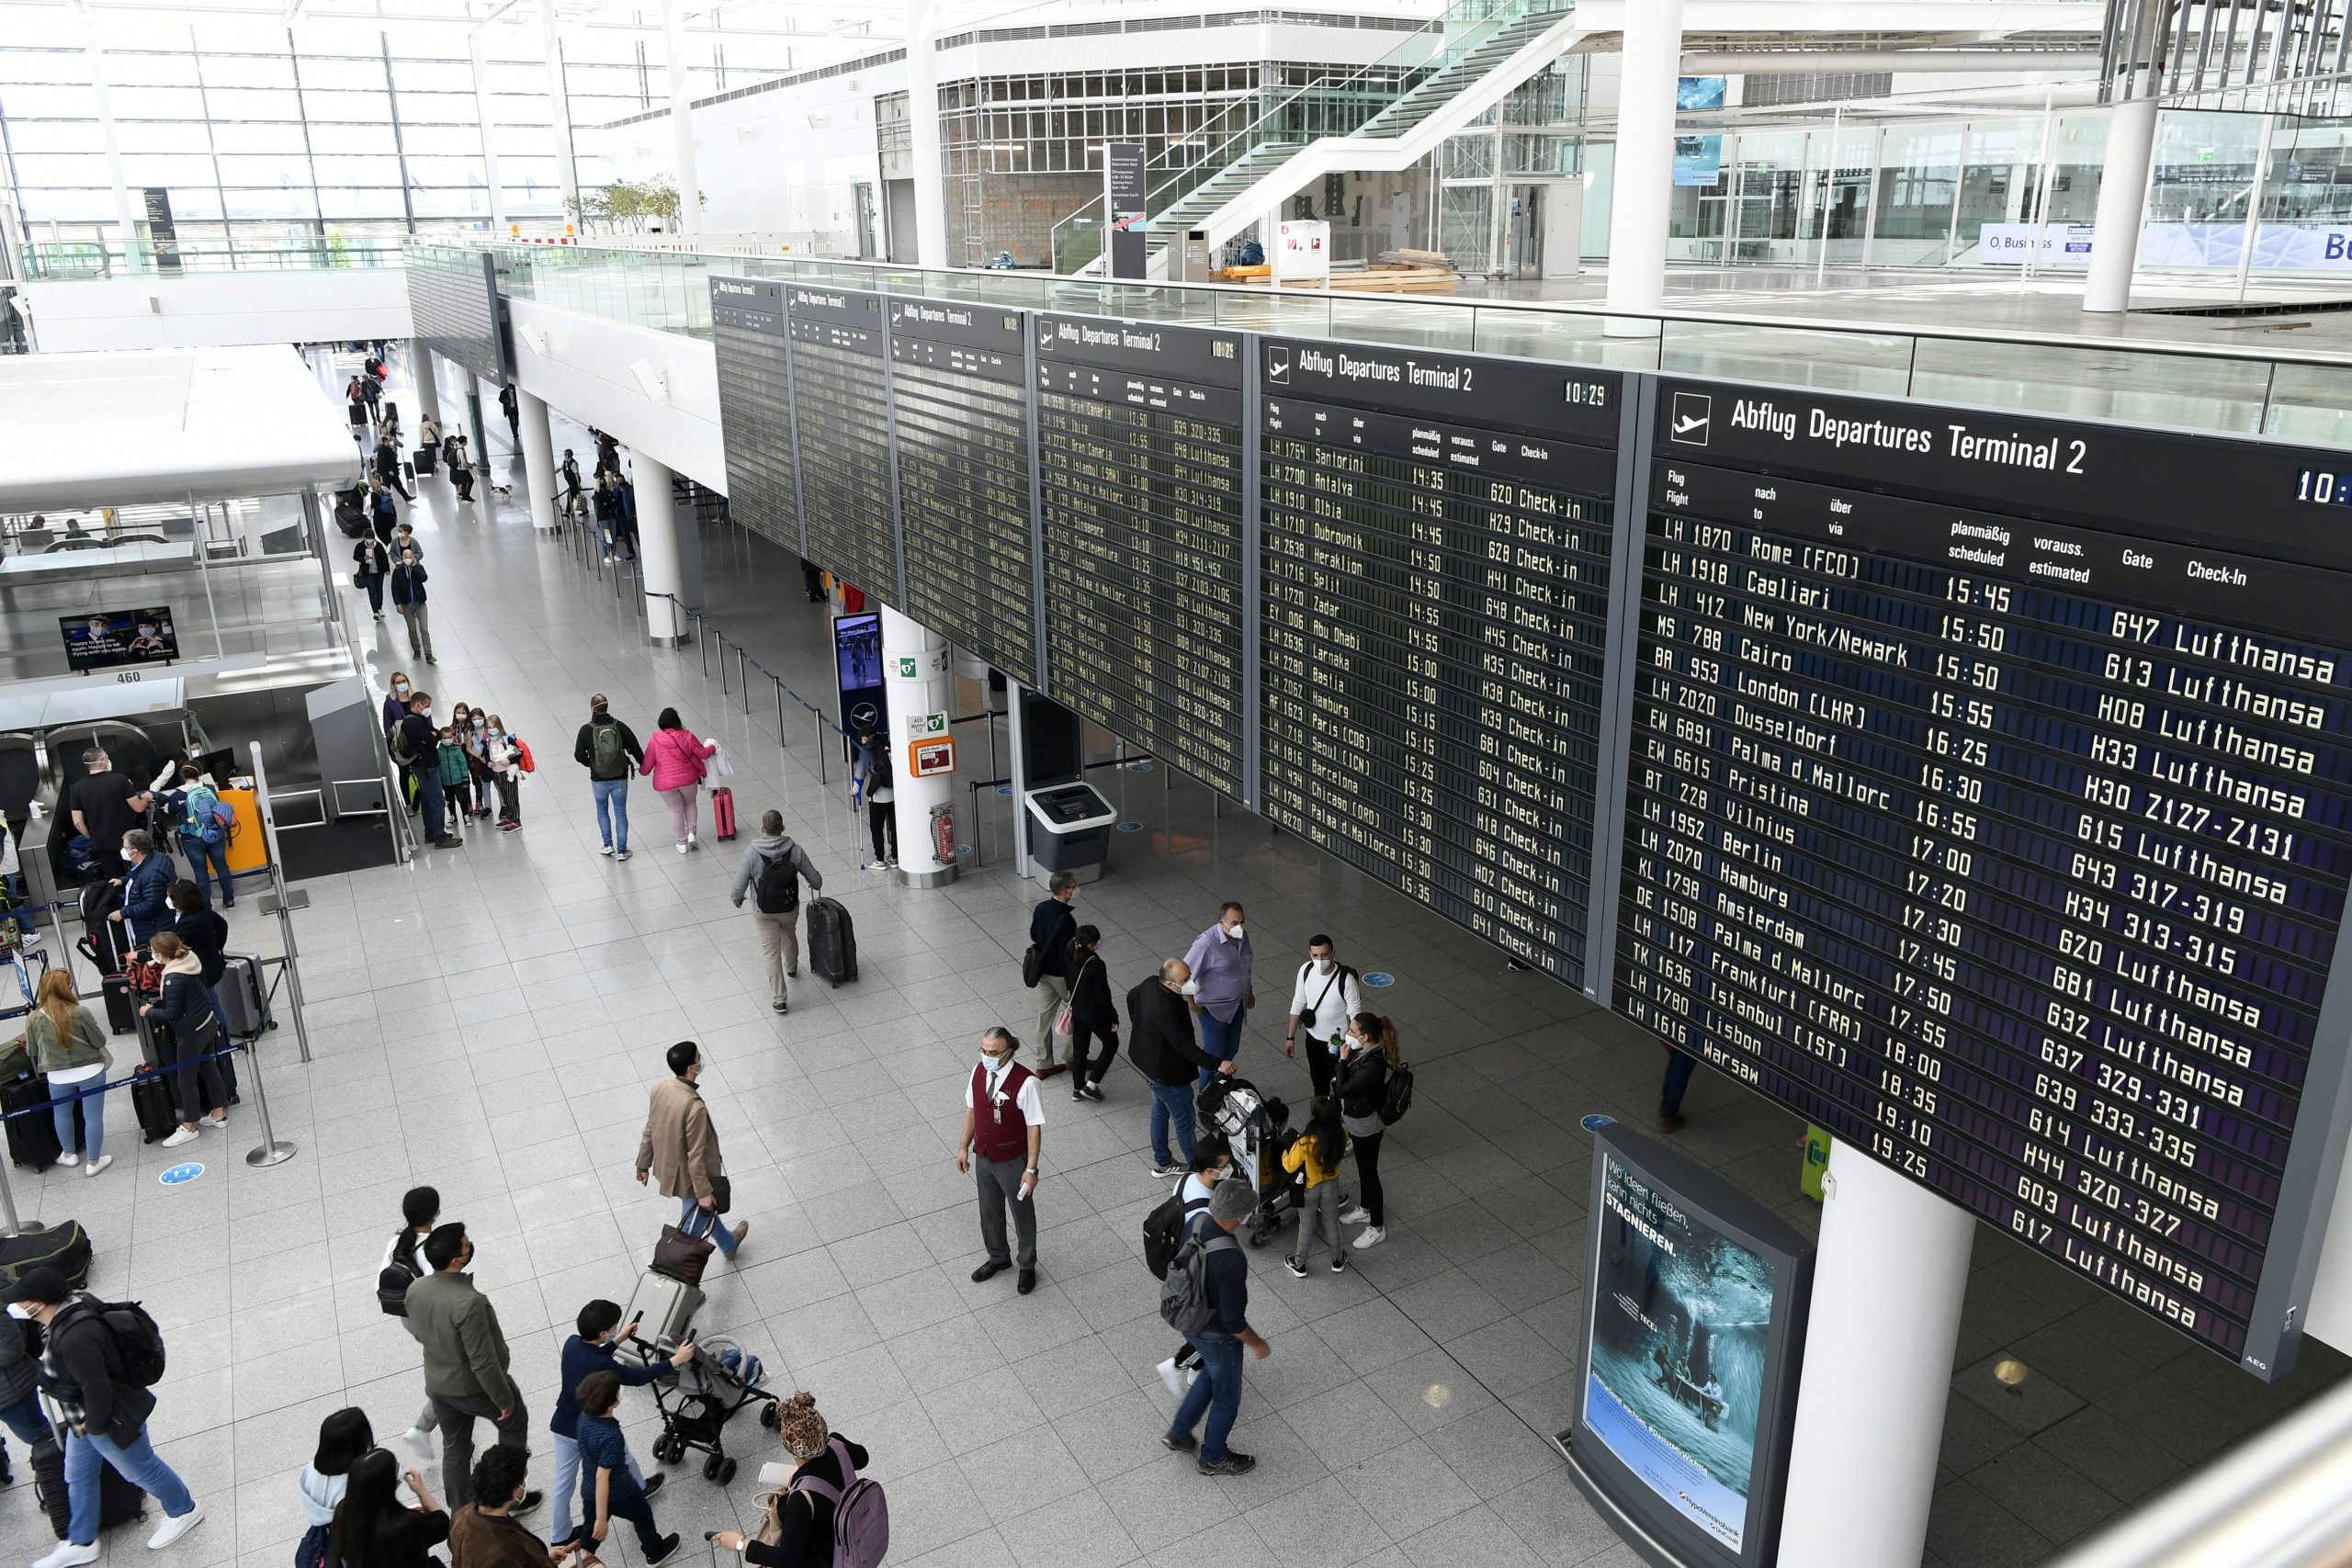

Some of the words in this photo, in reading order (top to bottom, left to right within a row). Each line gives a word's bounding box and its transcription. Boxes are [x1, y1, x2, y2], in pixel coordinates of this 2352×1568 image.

[904, 303, 919, 321] Abflug
[920, 305, 945, 323] Departures
[946, 309, 967, 325] Terminal
[967, 310, 972, 326] 2
[1058, 322, 1079, 344] Abflug
[1082, 325, 1119, 347] Departures
[1123, 329, 1153, 351] Terminal
[1155, 333, 1161, 352] 2
[1299, 350, 1332, 378] Abflug
[1340, 354, 1400, 382] Departures
[1407, 361, 1459, 389] Terminal
[1464, 367, 1472, 391] 2
[1566, 382, 1604, 406] 10:29
[1491, 440, 1507, 454] Gate
[1521, 445, 1548, 460] Check-In
[1731, 400, 1796, 441] Abflug
[1809, 408, 1931, 452] Departures
[1948, 424, 2058, 469] Terminal
[2066, 440, 2086, 474] 2
[1667, 490, 1689, 506] Flight
[1754, 508, 1762, 520] to
[1828, 522, 1843, 536] via
[1949, 545, 2005, 567] scheduled
[2030, 561, 2090, 583] estimated
[1668, 469, 1685, 487] Flug
[1755, 488, 1776, 501] nach
[1830, 499, 1852, 513] über
[1951, 521, 2010, 546] planmäßig
[2034, 537, 2084, 557] vorauss.
[2122, 549, 2153, 569] Gate
[2188, 560, 2246, 586] Check-In
[1665, 518, 1683, 540] LH
[1694, 525, 1731, 551] 1870
[1751, 536, 1792, 564] Rome
[1947, 577, 2010, 612] 15:45
[2176, 625, 2334, 683] Lufthansa
[118, 672, 140, 683] 460
[1660, 583, 1678, 605] LH
[1697, 592, 1724, 618] 412
[1744, 604, 1773, 631] New
[1787, 615, 1907, 667] York/Newark
[1937, 654, 1998, 690] 15:50
[2098, 694, 2144, 728] H08
[2160, 710, 2314, 773] Lufthansa
[1194, 717, 1231, 752] Lufthansa
[1656, 647, 1672, 670] BA
[1690, 658, 1719, 683] 953
[1738, 671, 1799, 708] London
[1927, 728, 1987, 766] 16:25
[2085, 774, 2131, 810] H30
[2145, 794, 2292, 861] Z127-Z131
[1645, 770, 1662, 792] BT
[1680, 783, 1707, 809] 228
[1726, 800, 1794, 844] Vilnius
[1907, 871, 1966, 911] 17:20
[2117, 951, 2259, 1028] Lufthansa
[1634, 914, 1651, 937] LH
[1669, 931, 1694, 956] 117
[1712, 952, 1795, 1010] Frankfurt
[1885, 1038, 1940, 1081] 18:00
[2084, 1135, 2218, 1220] Lufthansa
[1629, 998, 1645, 1020] LH
[1655, 1012, 1686, 1043] 1616
[1704, 1039, 1758, 1084] Warsaw
[1873, 1133, 1927, 1178] 19:25
[2065, 1238, 2196, 1328] Lufthansa
[1608, 1174, 1627, 1201] kann
[1630, 1196, 1657, 1224] nichts
[1609, 1157, 1622, 1179] Wo
[1625, 1172, 1648, 1201] Ideen
[1652, 1192, 1689, 1230] fließen,
[1606, 1192, 1677, 1258] STAGNIEREN.
[2246, 1356, 2266, 1370] AEG
[1592, 1371, 1623, 1407] International
[1686, 1495, 1739, 1537] HypoVereinsbank
[1715, 1527, 1739, 1545] UniCredit
